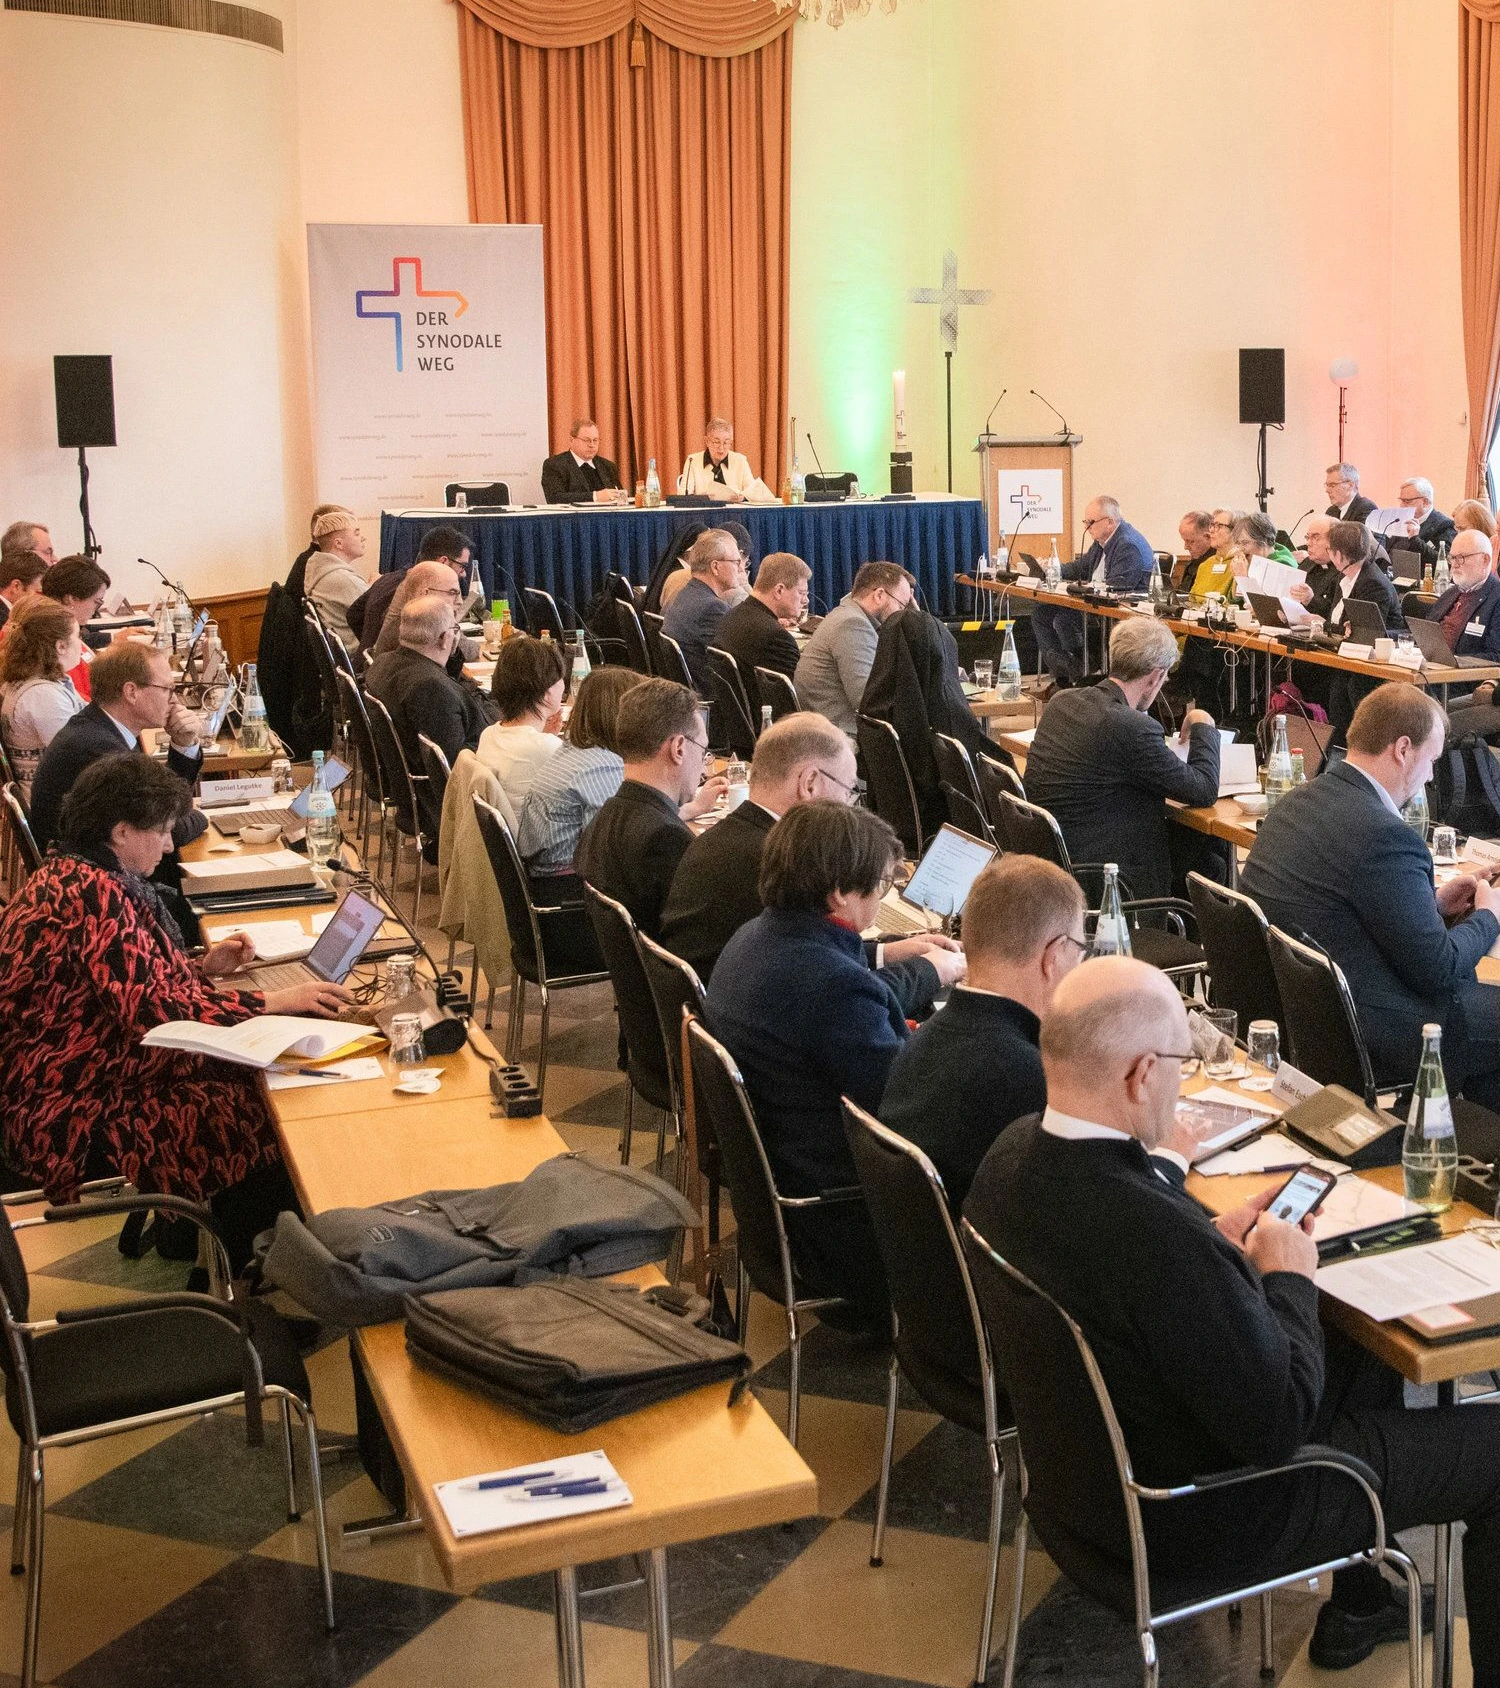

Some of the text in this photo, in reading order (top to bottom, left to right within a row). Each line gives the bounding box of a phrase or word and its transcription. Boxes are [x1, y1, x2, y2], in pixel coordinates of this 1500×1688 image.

[416, 311, 449, 326] DER
[416, 334, 502, 349] SYNODALE
[417, 357, 455, 372] WEG
[214, 782, 263, 792] Daniel Legutke
